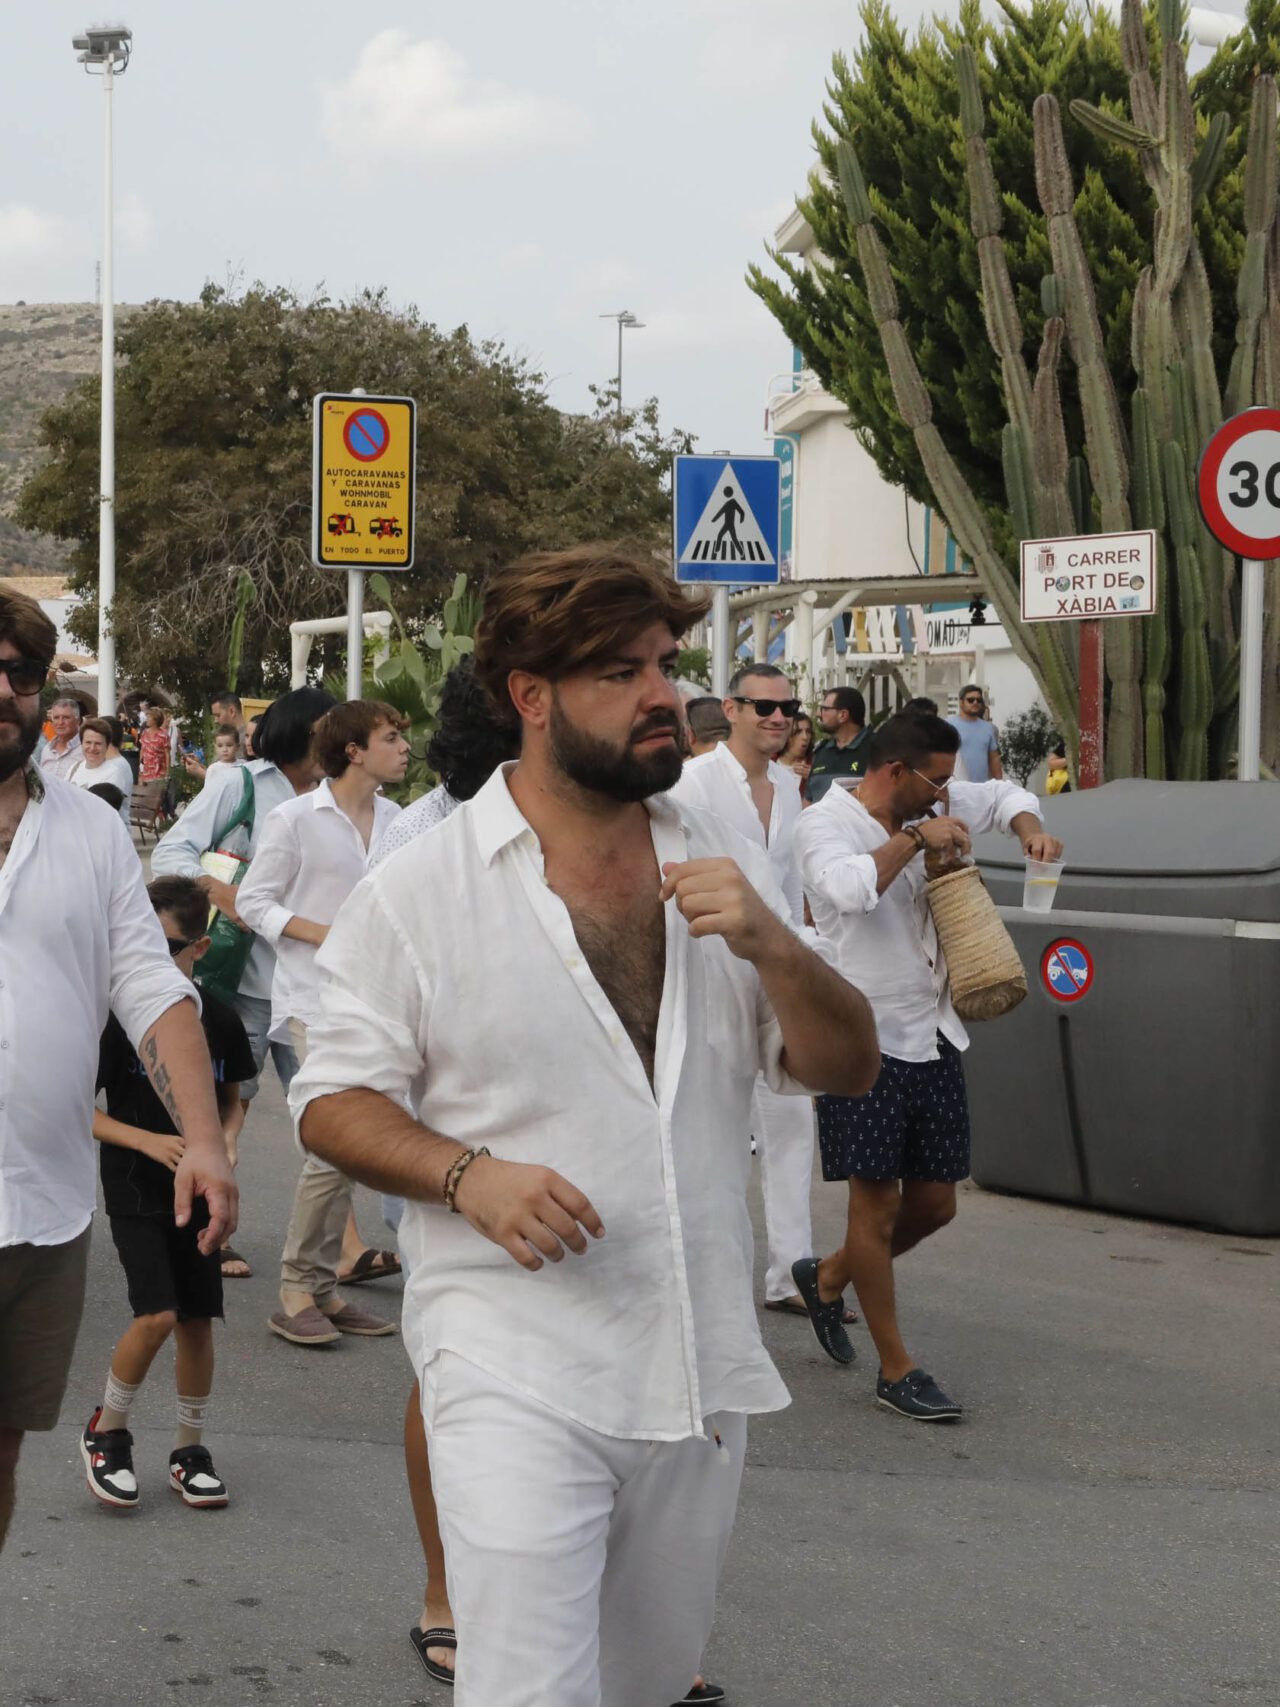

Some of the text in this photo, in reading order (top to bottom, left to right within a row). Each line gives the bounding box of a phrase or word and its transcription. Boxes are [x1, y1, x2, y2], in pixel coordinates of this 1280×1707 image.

[326, 469, 406, 479] AUTOCARAVANAS
[345, 480, 401, 489] CARAVANAS
[340, 489, 392, 499] WOHNMOBIL
[344, 500, 388, 508] CARAVAN
[379, 547, 405, 555] PUERTO
[1067, 549, 1141, 567] CARRER
[1044, 572, 1129, 592] PRT DE
[1056, 594, 1117, 614] XÀBIA
[925, 618, 955, 648] OMAD
